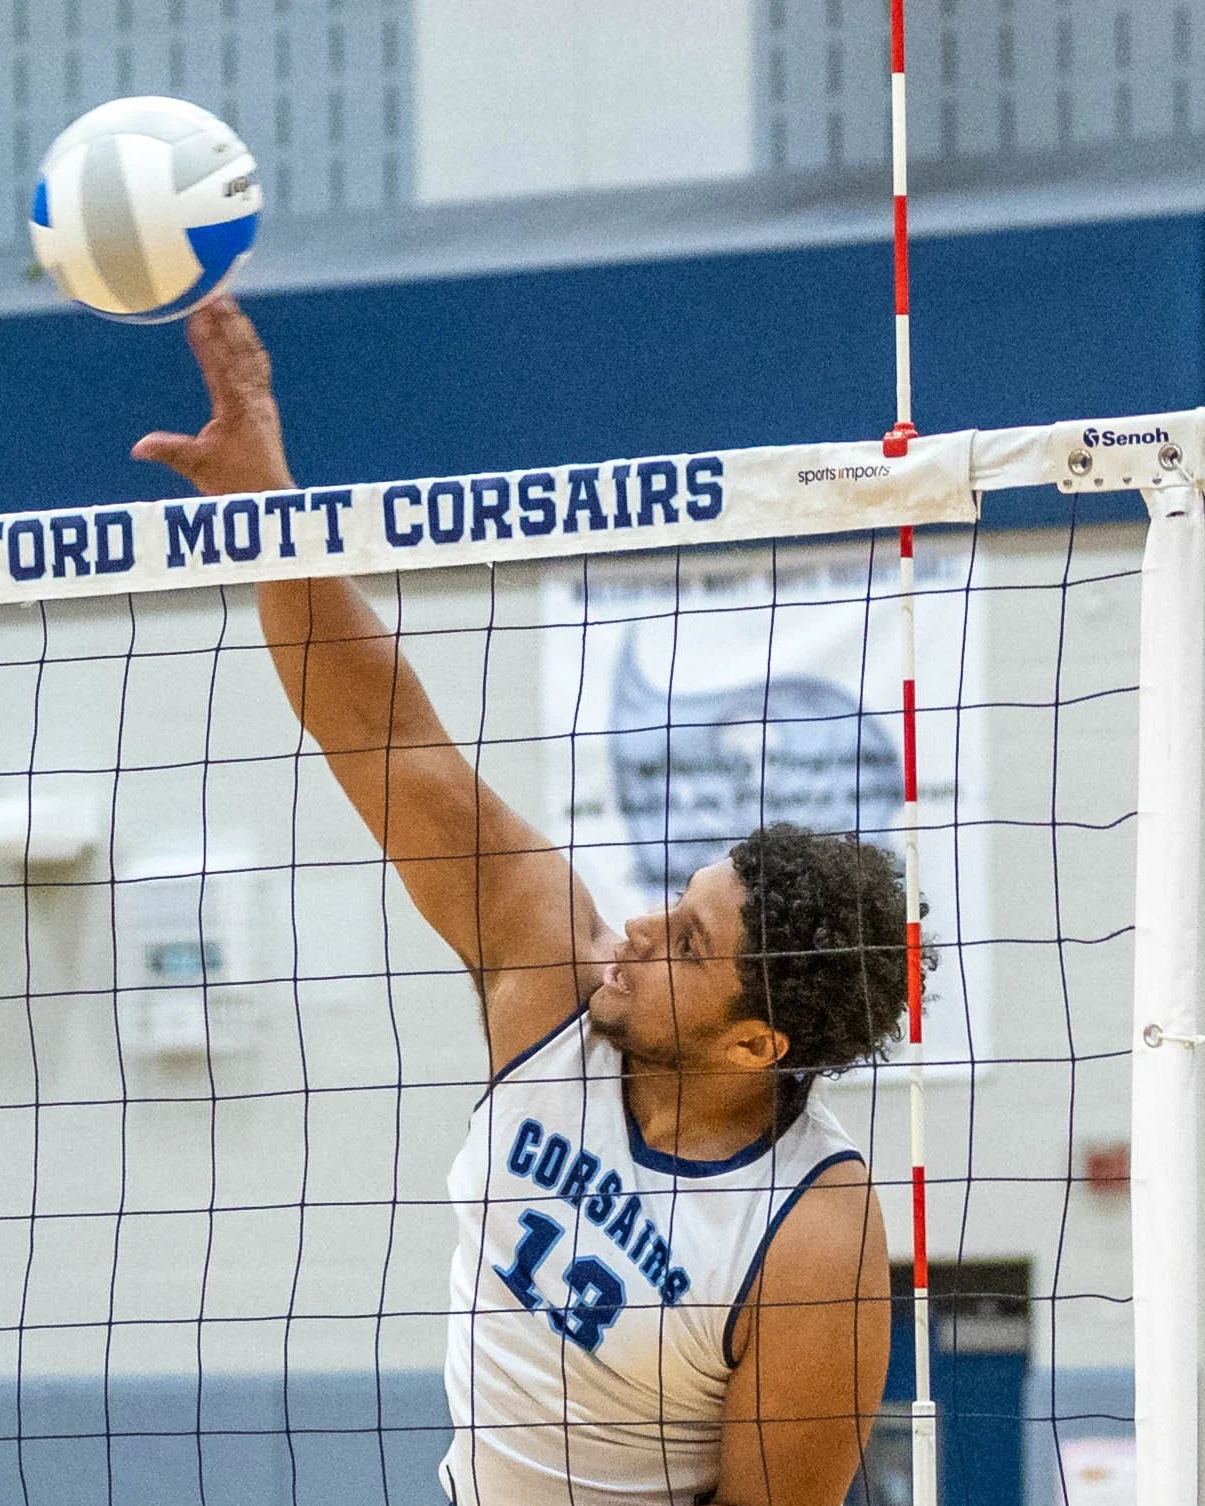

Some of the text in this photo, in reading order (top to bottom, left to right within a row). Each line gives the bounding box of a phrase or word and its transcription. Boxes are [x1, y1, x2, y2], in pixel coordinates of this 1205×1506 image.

[1101, 427, 1170, 447] Senoh
[797, 467, 836, 485] sports
[164, 490, 352, 568] MOTT
[383, 456, 724, 547] CORSAIRS
[507, 1117, 692, 1308] CORSAIRS
